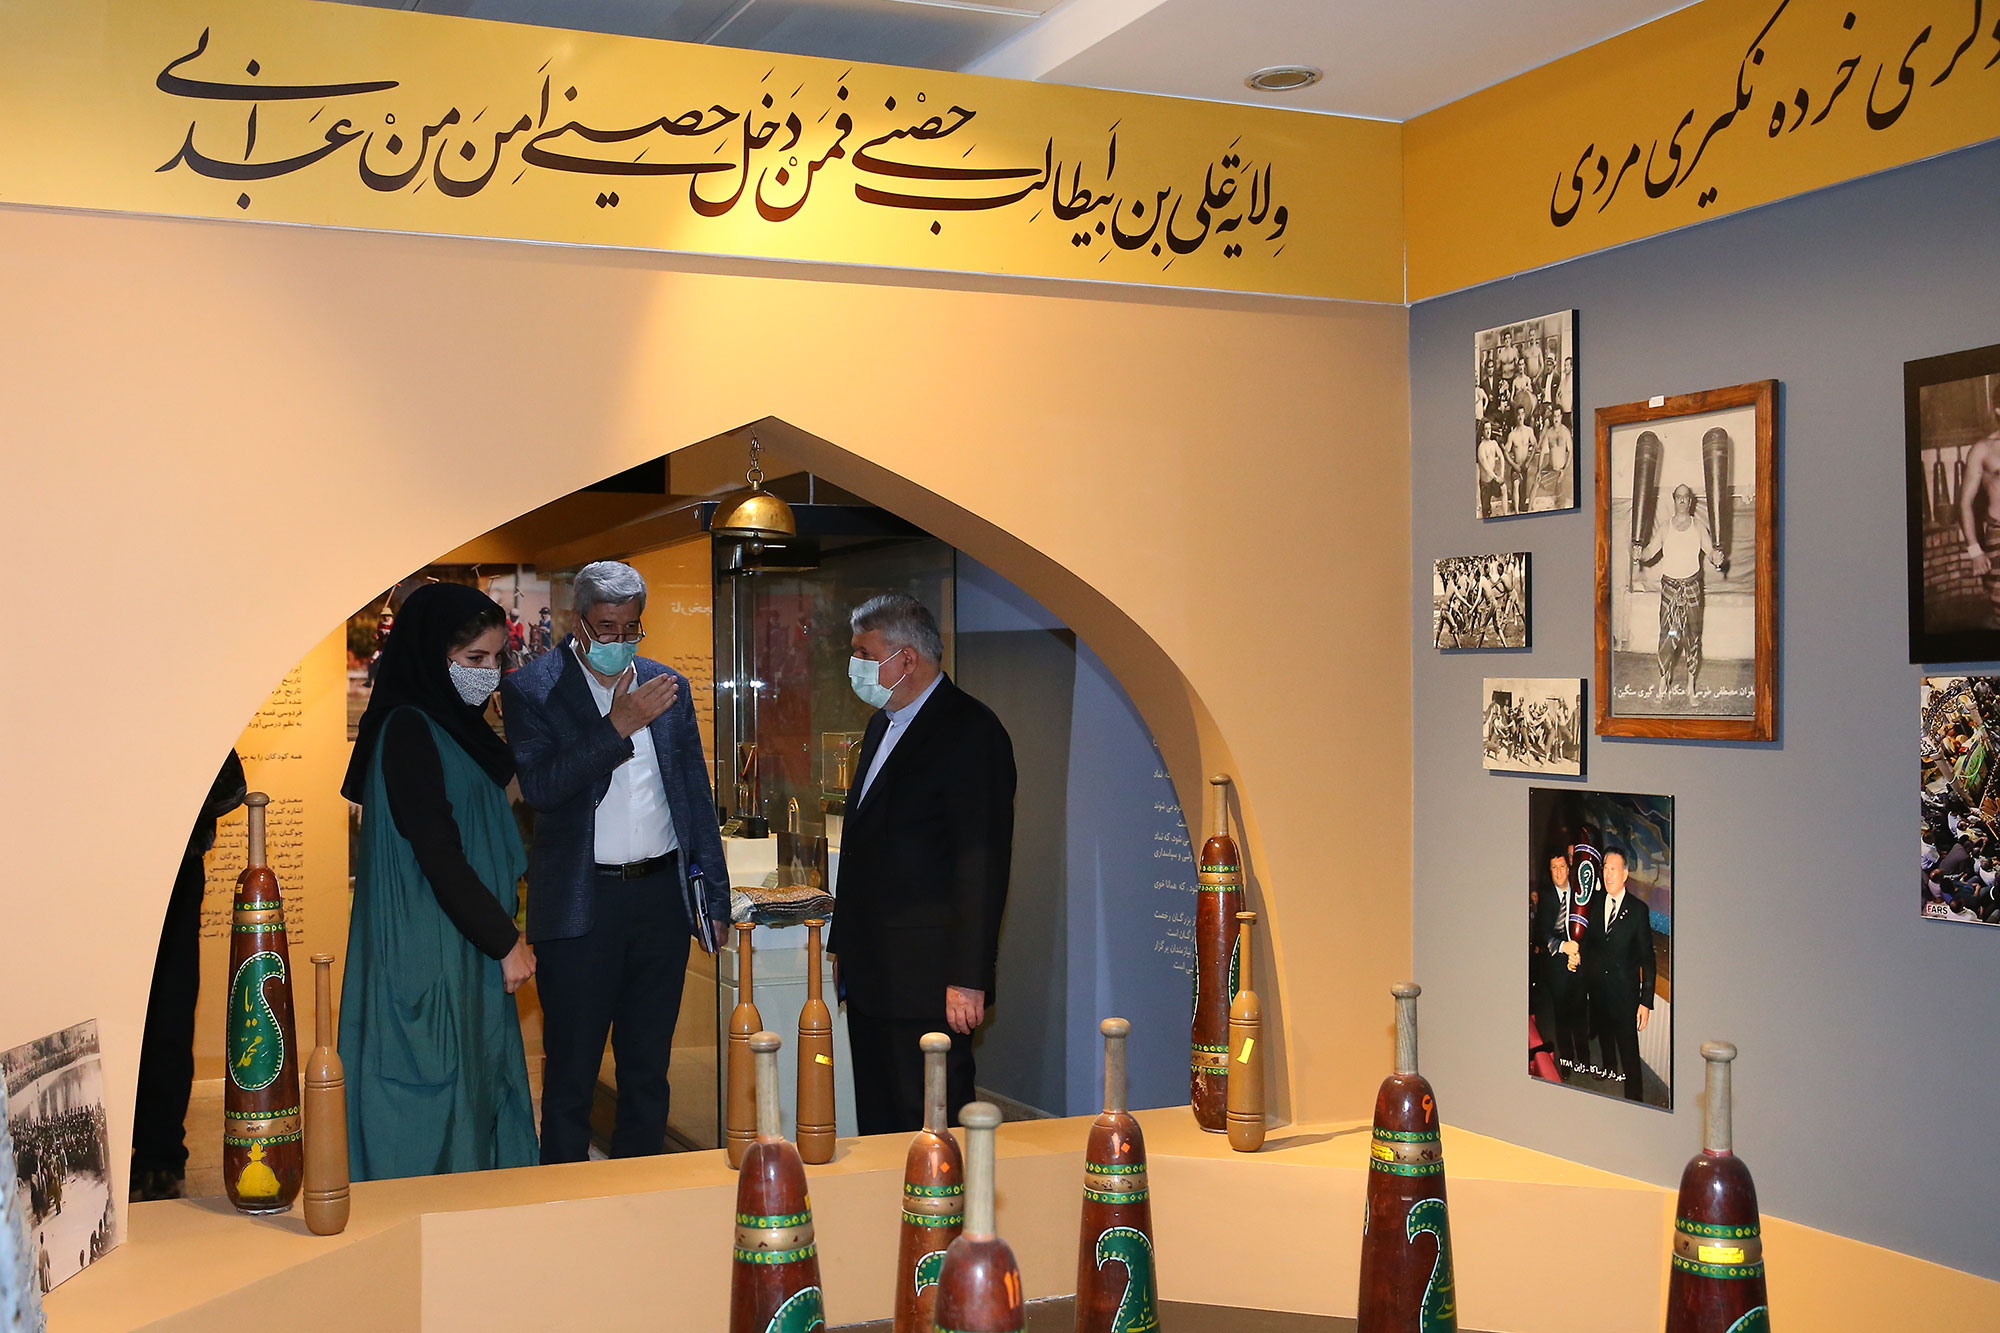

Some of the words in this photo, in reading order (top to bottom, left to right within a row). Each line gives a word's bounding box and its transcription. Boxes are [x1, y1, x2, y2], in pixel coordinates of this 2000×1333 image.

[1768, 12, 1862, 138] خرده
[1551, 143, 1641, 227] مردی
[1713, 685, 1738, 699] مصطفی
[1927, 904, 1948, 915] FARS
[1607, 1069, 1627, 1082] شهردار
